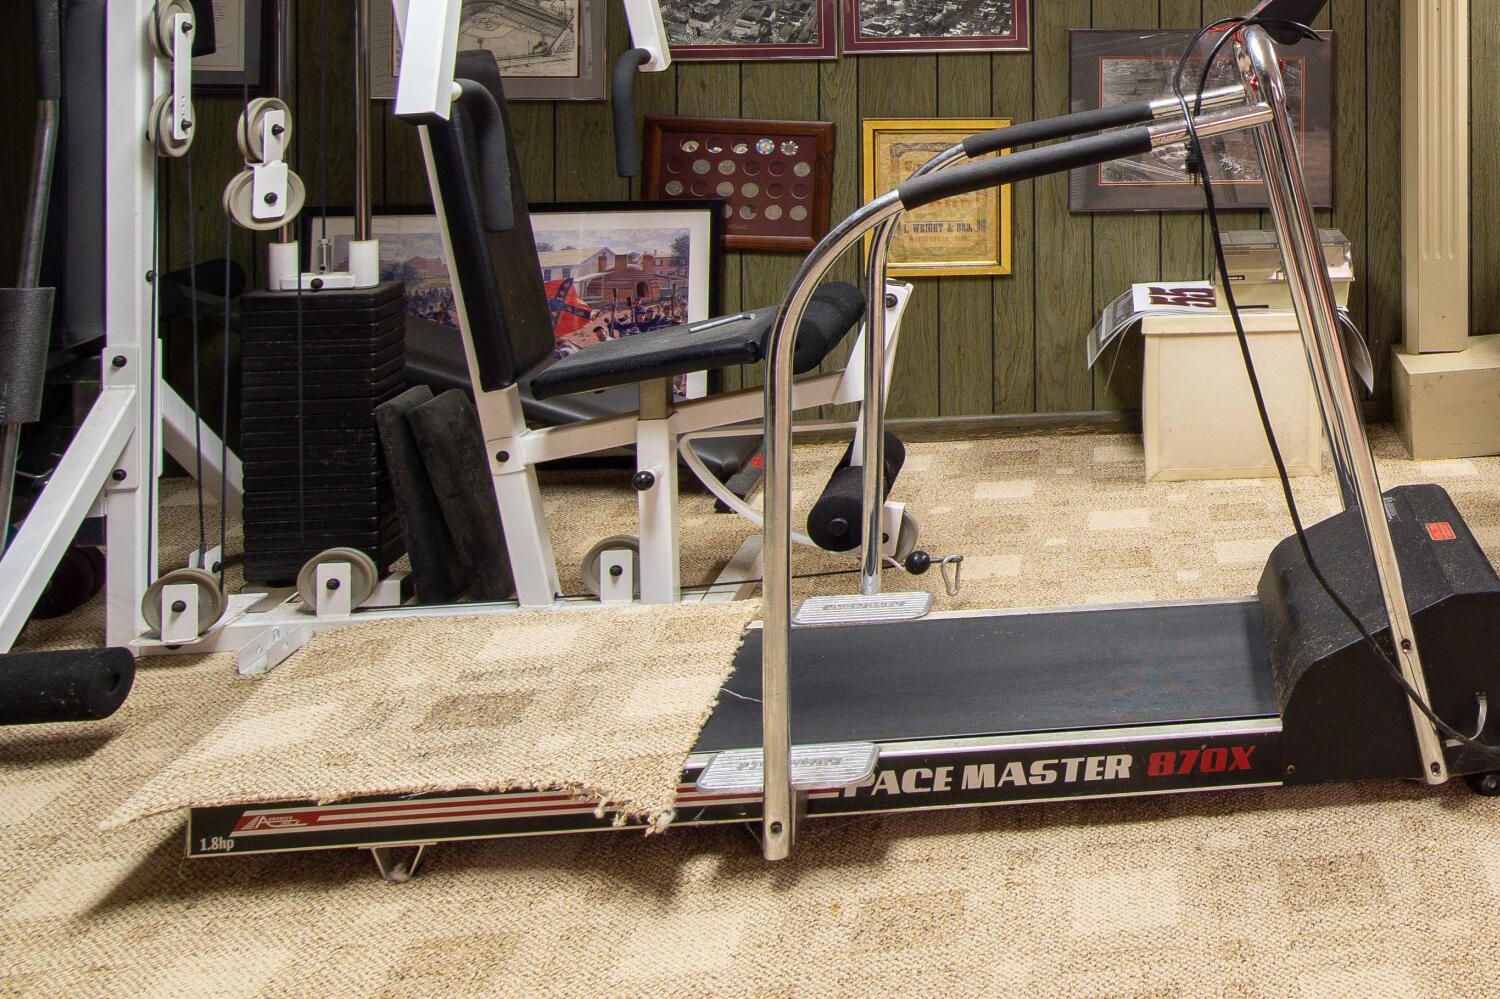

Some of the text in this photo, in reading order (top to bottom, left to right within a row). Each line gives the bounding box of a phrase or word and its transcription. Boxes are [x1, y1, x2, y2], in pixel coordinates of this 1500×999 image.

[912, 223, 944, 233] WRIGHT
[946, 223, 954, 233] &
[961, 754, 1133, 790] MASTER
[1147, 745, 1256, 777] 870X
[199, 836, 235, 852] 1.8hp
